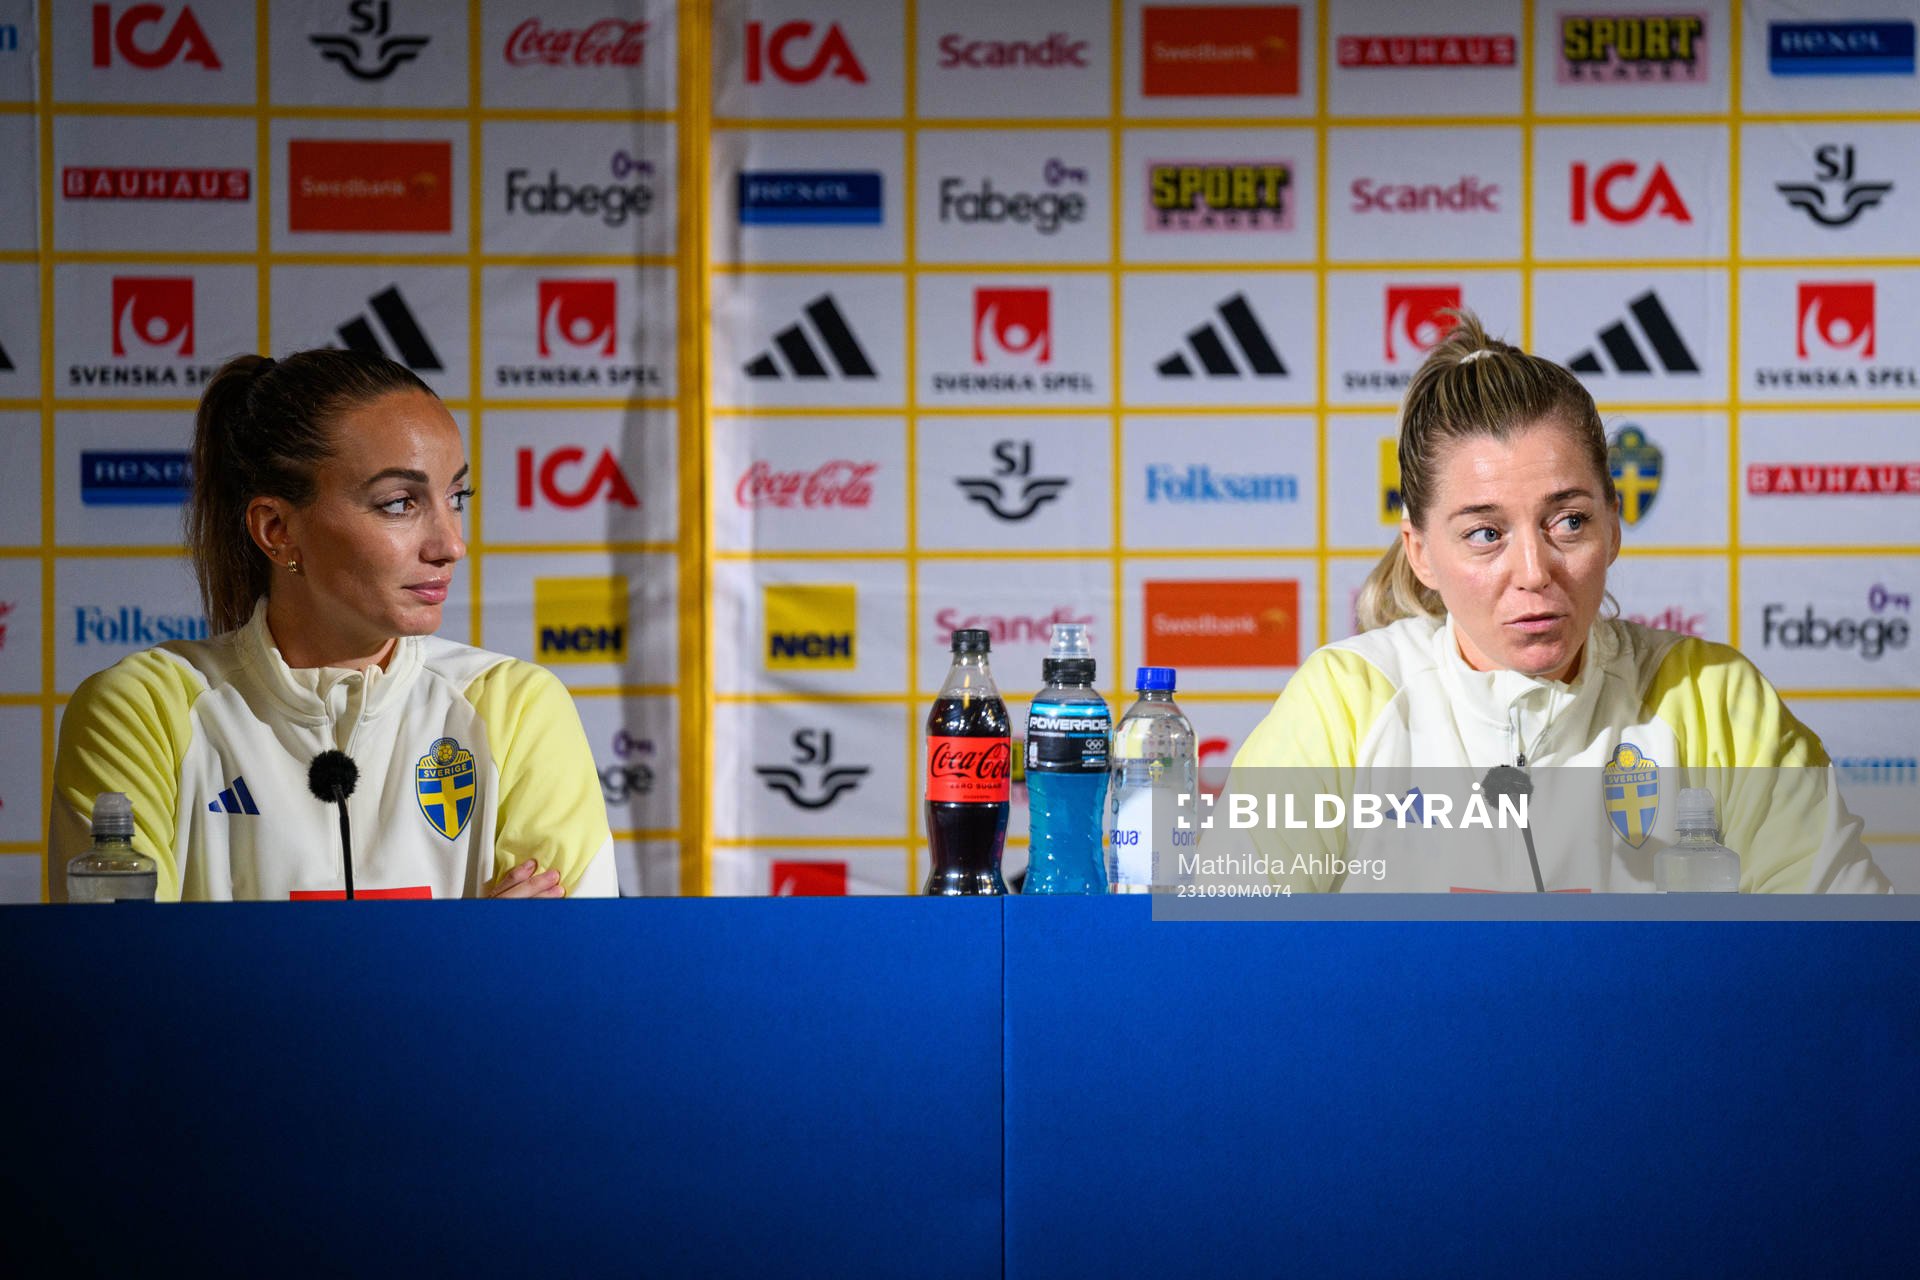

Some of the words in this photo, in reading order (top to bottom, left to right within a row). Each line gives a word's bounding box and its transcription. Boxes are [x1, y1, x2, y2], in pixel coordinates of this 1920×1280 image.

[350, 0, 391, 34] SJ
[92, 3, 222, 69] ICA
[744, 21, 868, 84] ICA
[938, 32, 1089, 70] Scandic
[1341, 38, 1514, 65] BAUHAUS
[1562, 16, 1705, 62] SPORT
[1815, 145, 1855, 182] SJ
[65, 169, 248, 198] BAUHAUS
[505, 170, 655, 227] Fabege
[1149, 165, 1290, 211] SPORT
[1350, 176, 1499, 213] Scandic
[1571, 161, 1692, 224] ICA
[939, 178, 1088, 234] Fabege
[69, 366, 177, 386] SVENSKA
[496, 366, 600, 387] SVENSKA
[608, 367, 661, 387] SPEL
[932, 373, 1036, 392] SVENSKA
[1042, 373, 1094, 392] SPEL
[1756, 368, 1860, 388] SVENSKA
[1867, 368, 1918, 388] SPEL
[993, 441, 1032, 476] SJ
[516, 447, 640, 509] ICA
[1144, 464, 1299, 504] Folksam
[1763, 604, 1911, 659] Fabege
[1030, 716, 1108, 731] POWERADE
[792, 729, 832, 766] SJ
[423, 762, 468, 778] SVERIGE
[1608, 772, 1653, 784] SVERIGE
